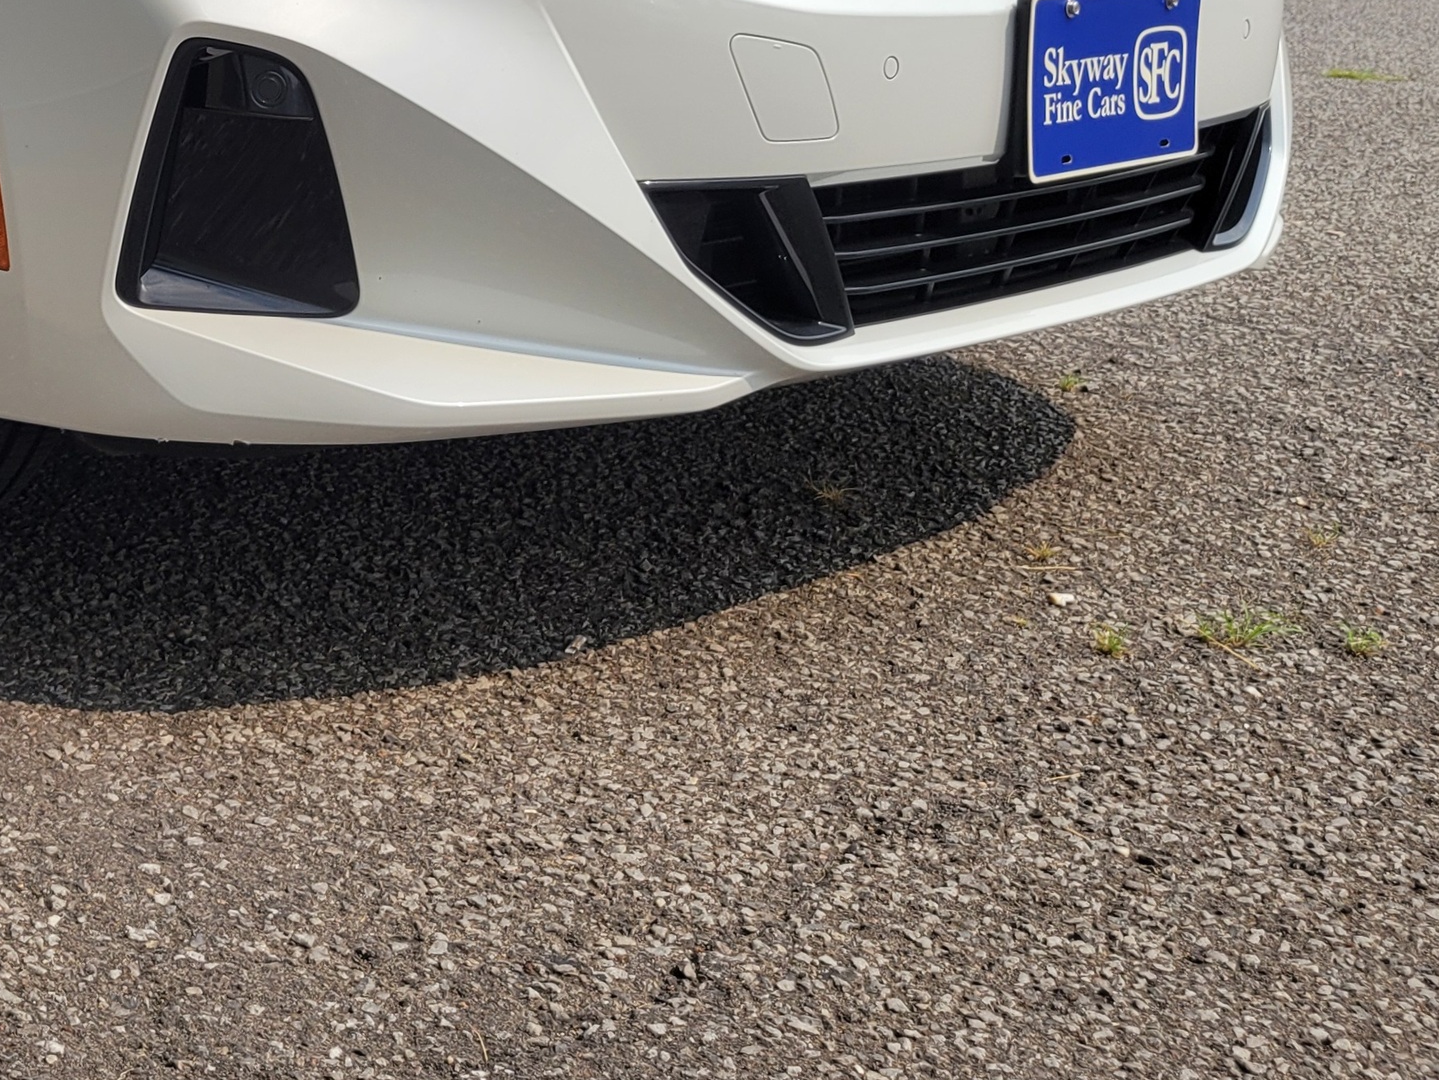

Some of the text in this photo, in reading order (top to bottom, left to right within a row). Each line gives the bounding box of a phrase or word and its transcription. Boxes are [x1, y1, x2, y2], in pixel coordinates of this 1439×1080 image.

[1043, 41, 1181, 105] Skyway SFC
[1043, 87, 1126, 126] Fine Cars
